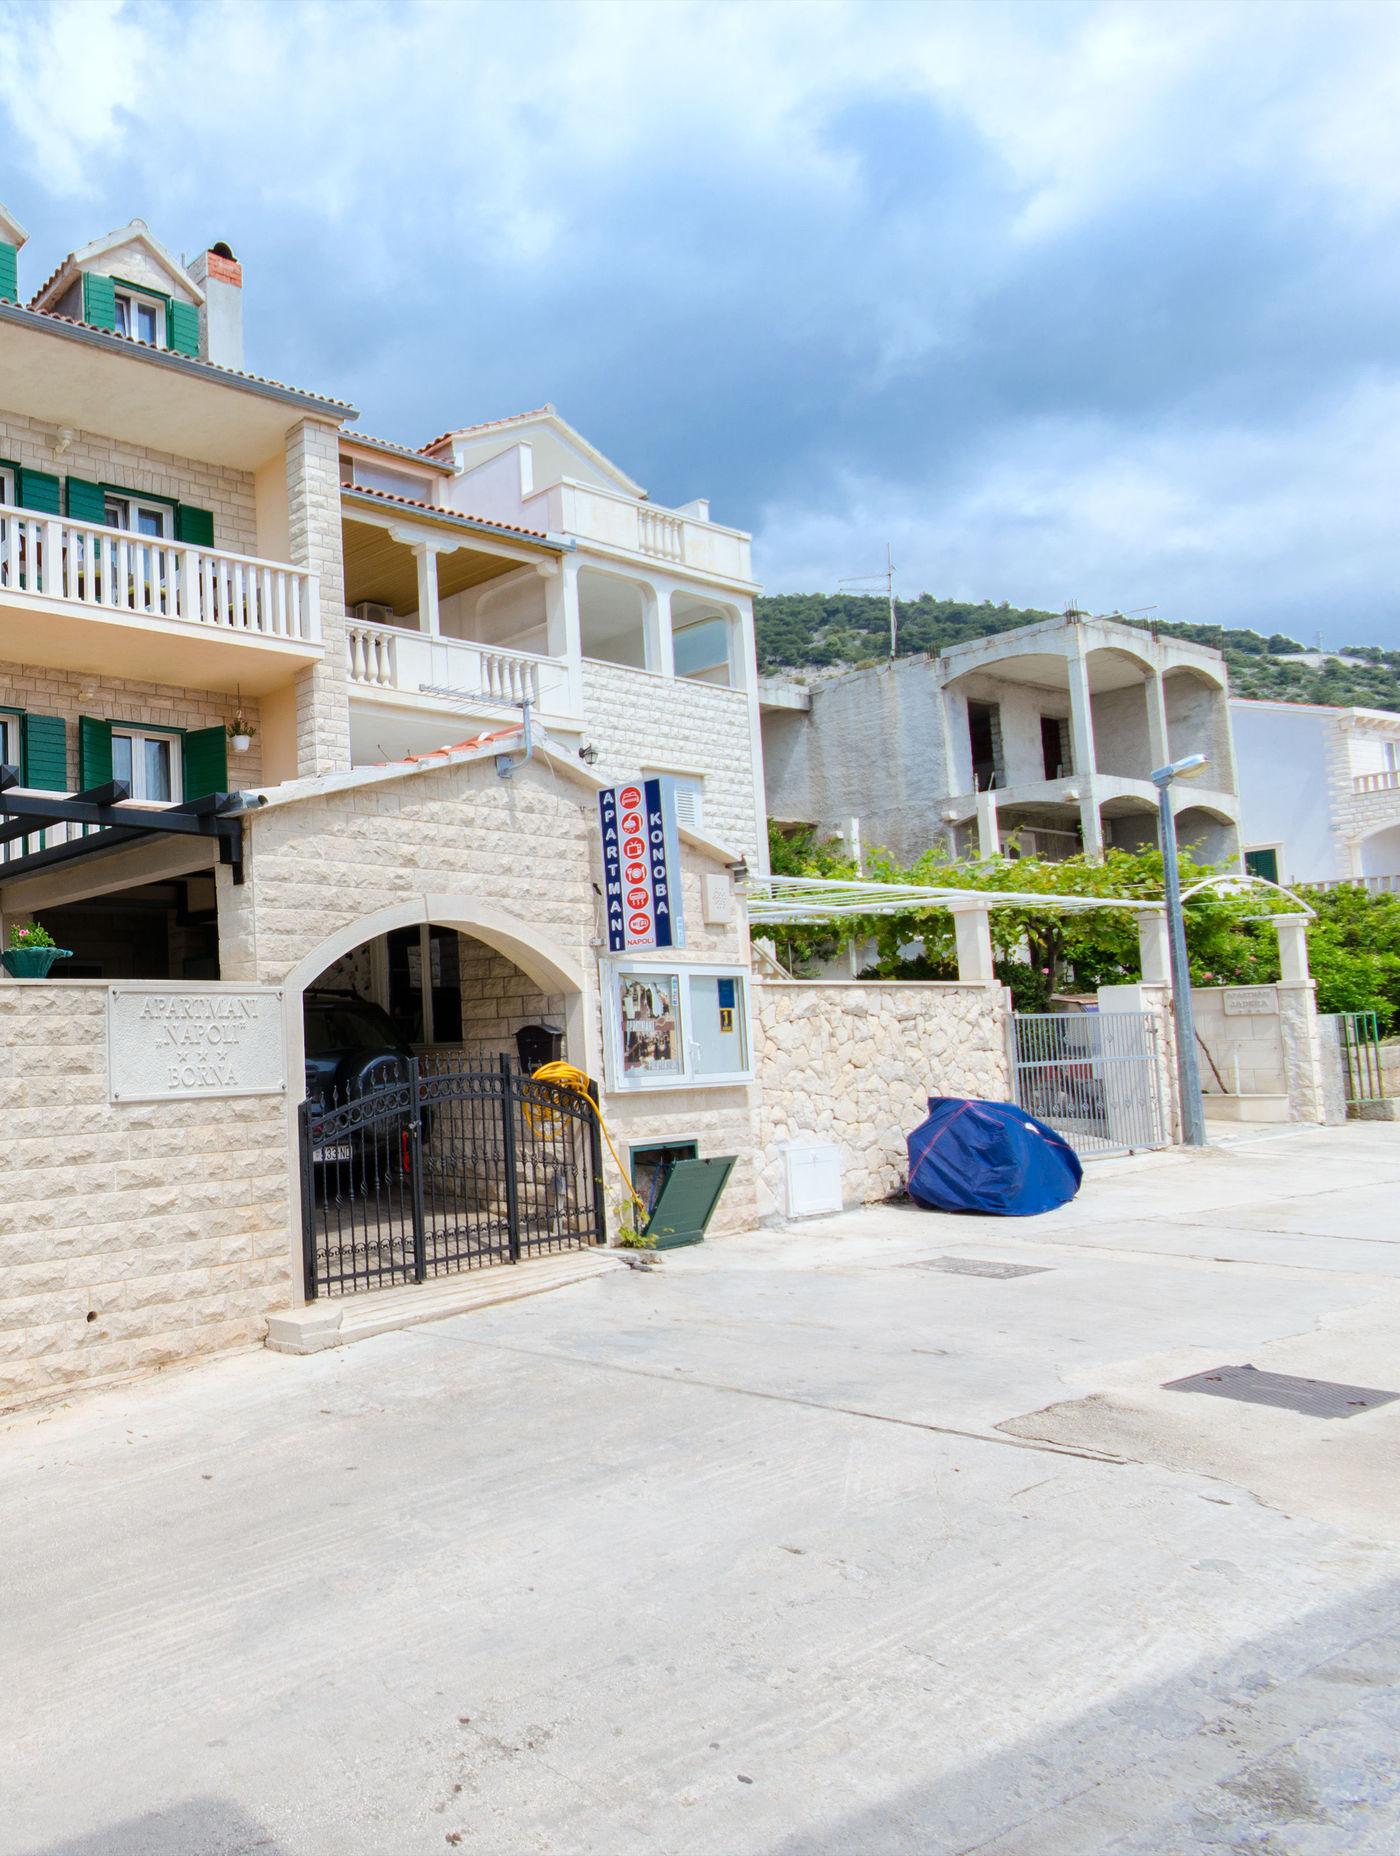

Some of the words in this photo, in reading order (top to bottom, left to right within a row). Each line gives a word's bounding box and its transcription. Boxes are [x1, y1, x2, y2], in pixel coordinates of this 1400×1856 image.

[603, 791, 623, 950] APARTMANI
[649, 811, 669, 915] KONOBA
[627, 937, 654, 946] NAPOLI
[140, 998, 259, 1020] APARTMANI
[167, 1066, 240, 1089] BORNA
